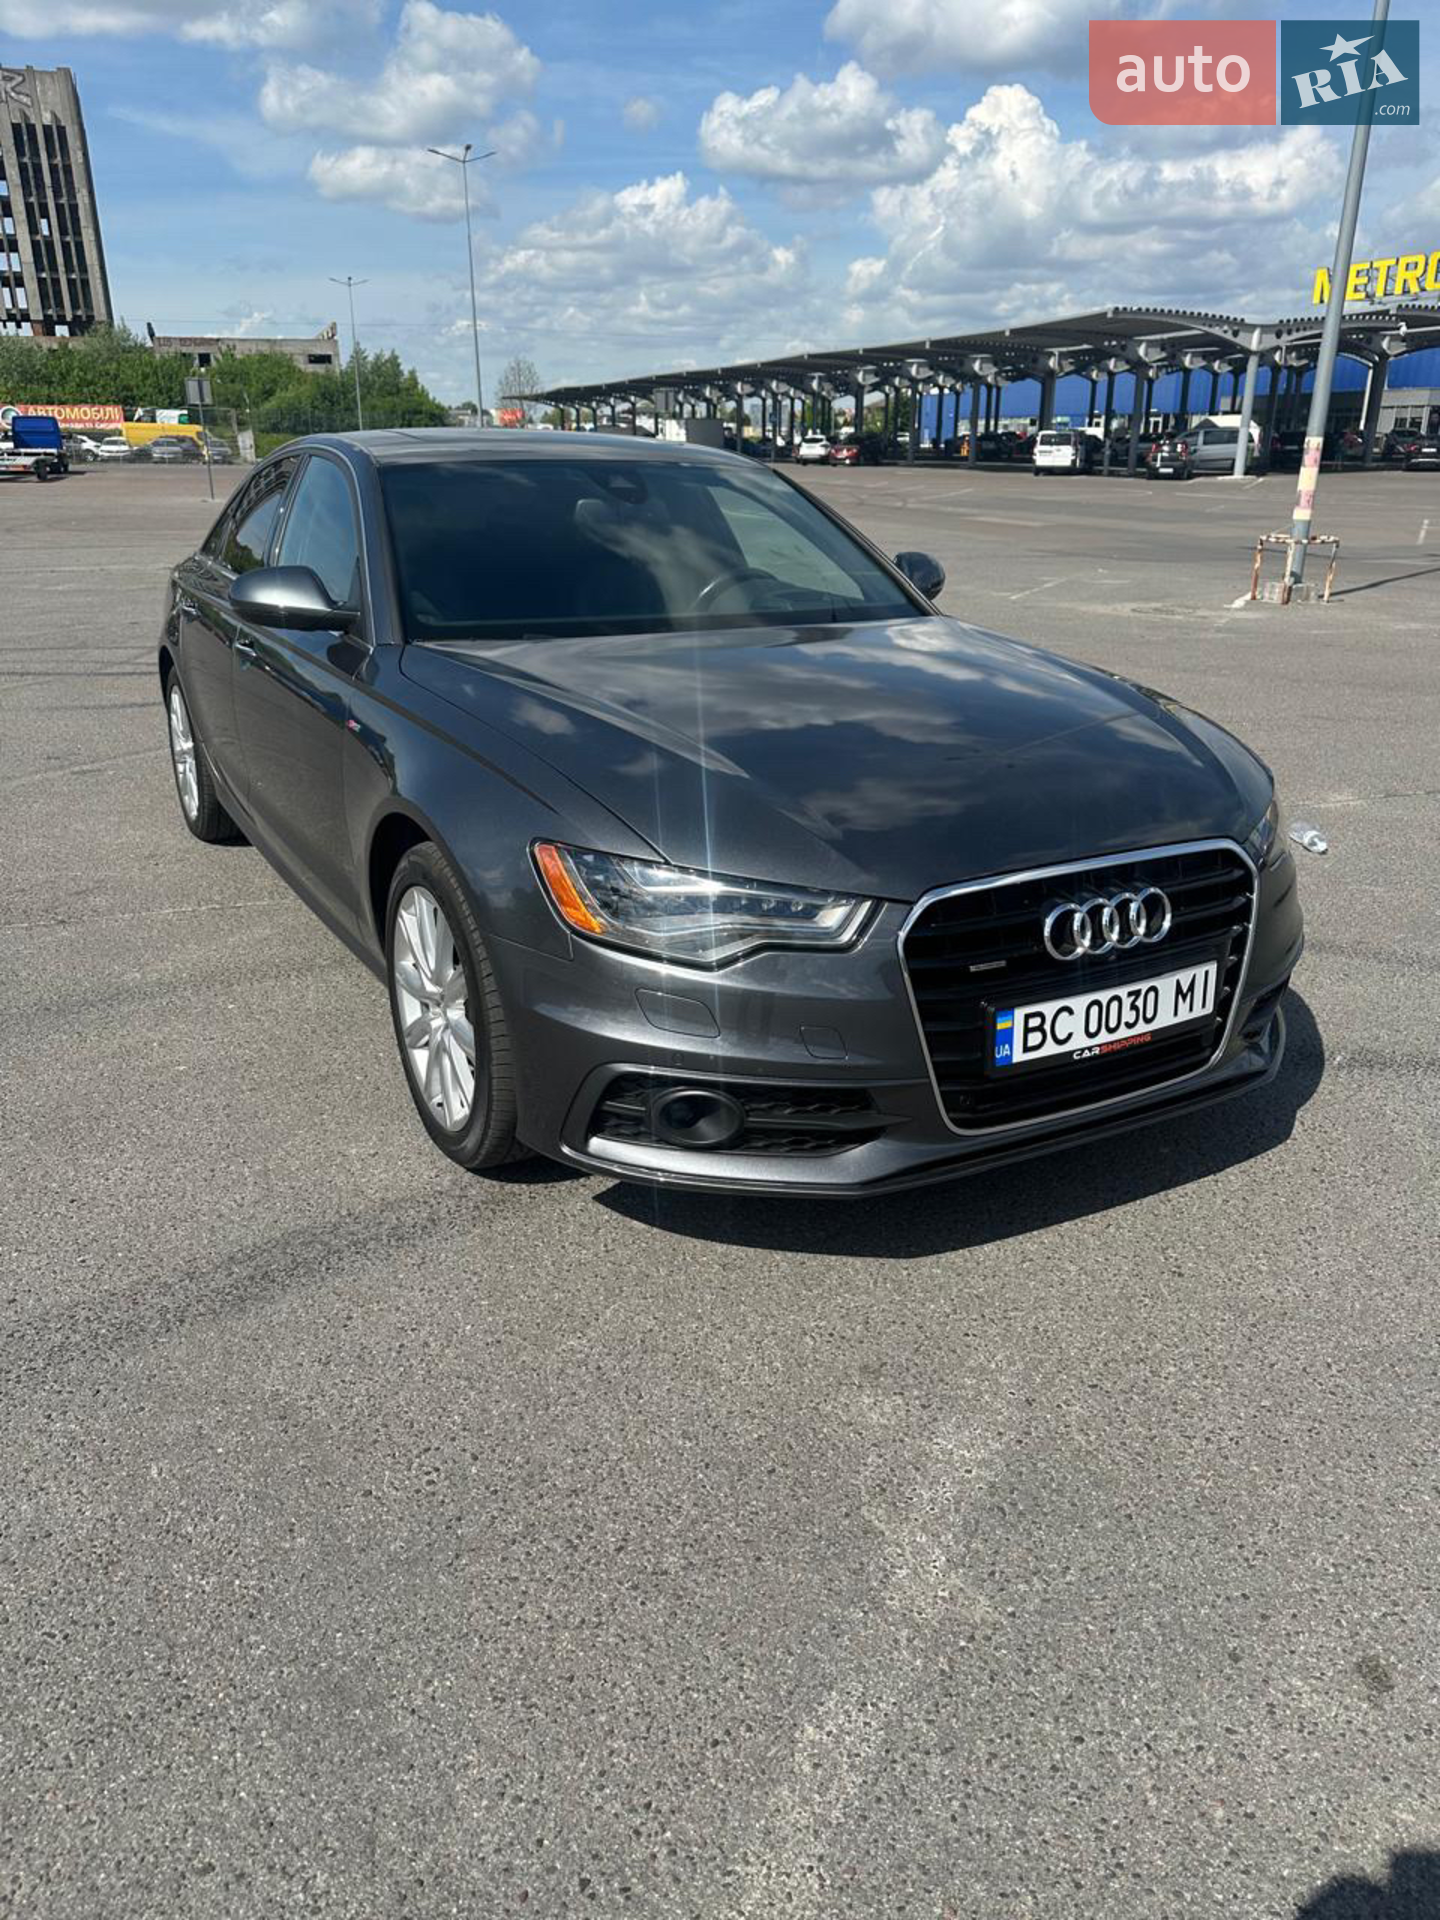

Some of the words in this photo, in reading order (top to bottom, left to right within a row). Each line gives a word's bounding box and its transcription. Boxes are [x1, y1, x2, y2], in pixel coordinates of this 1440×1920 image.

[1022, 1006, 1075, 1054] BC
[1084, 985, 1159, 1039] 0030
[1173, 969, 1210, 1017] MI
[995, 1044, 1011, 1059] UA
